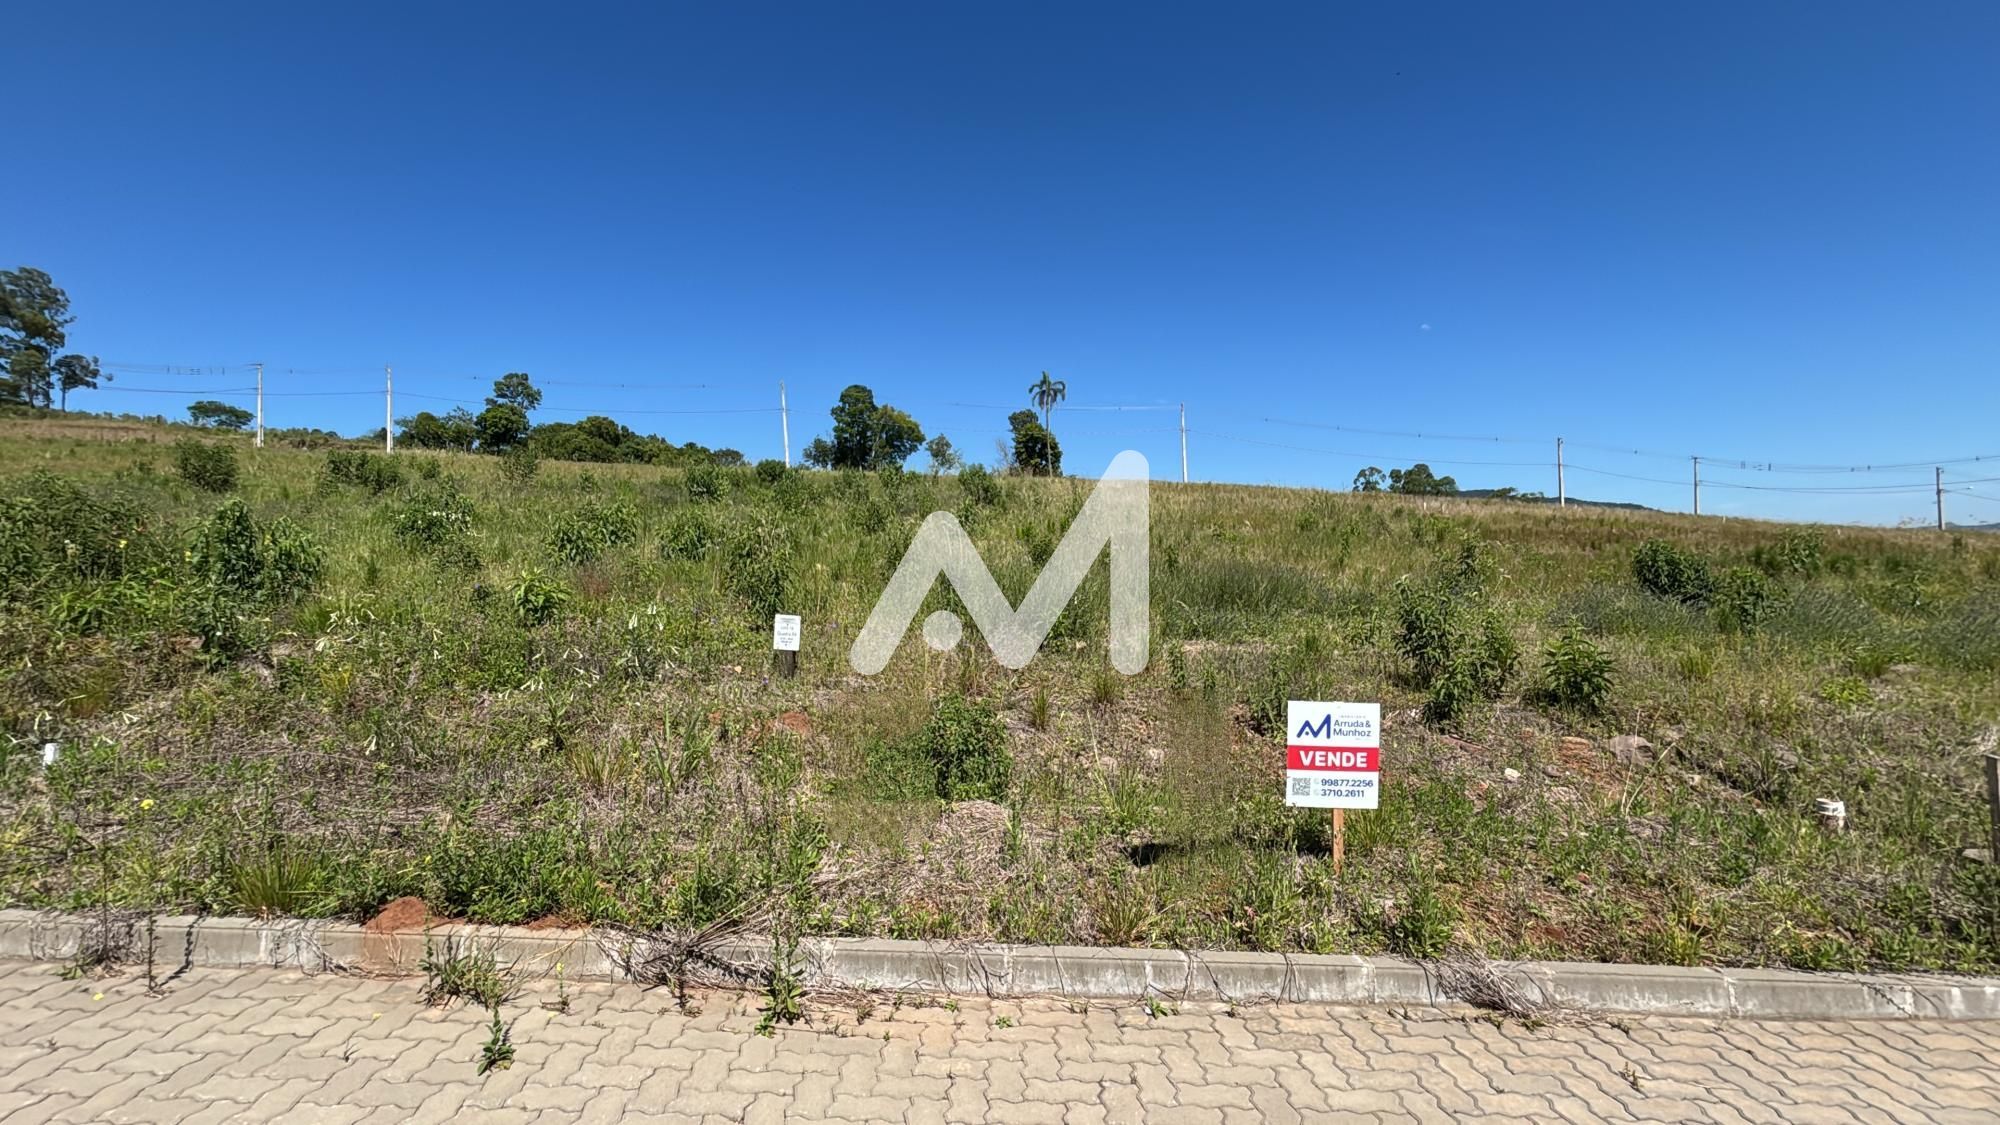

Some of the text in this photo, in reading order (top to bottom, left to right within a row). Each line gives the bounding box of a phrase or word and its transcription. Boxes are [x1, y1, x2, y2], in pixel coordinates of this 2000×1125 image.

[1334, 720, 1371, 728] Arruda &
[1333, 728, 1371, 737] Munhoz
[1299, 750, 1368, 768] VENDE
[1321, 778, 1373, 788] 99877.2256
[1321, 789, 1364, 797] 3710.2611
